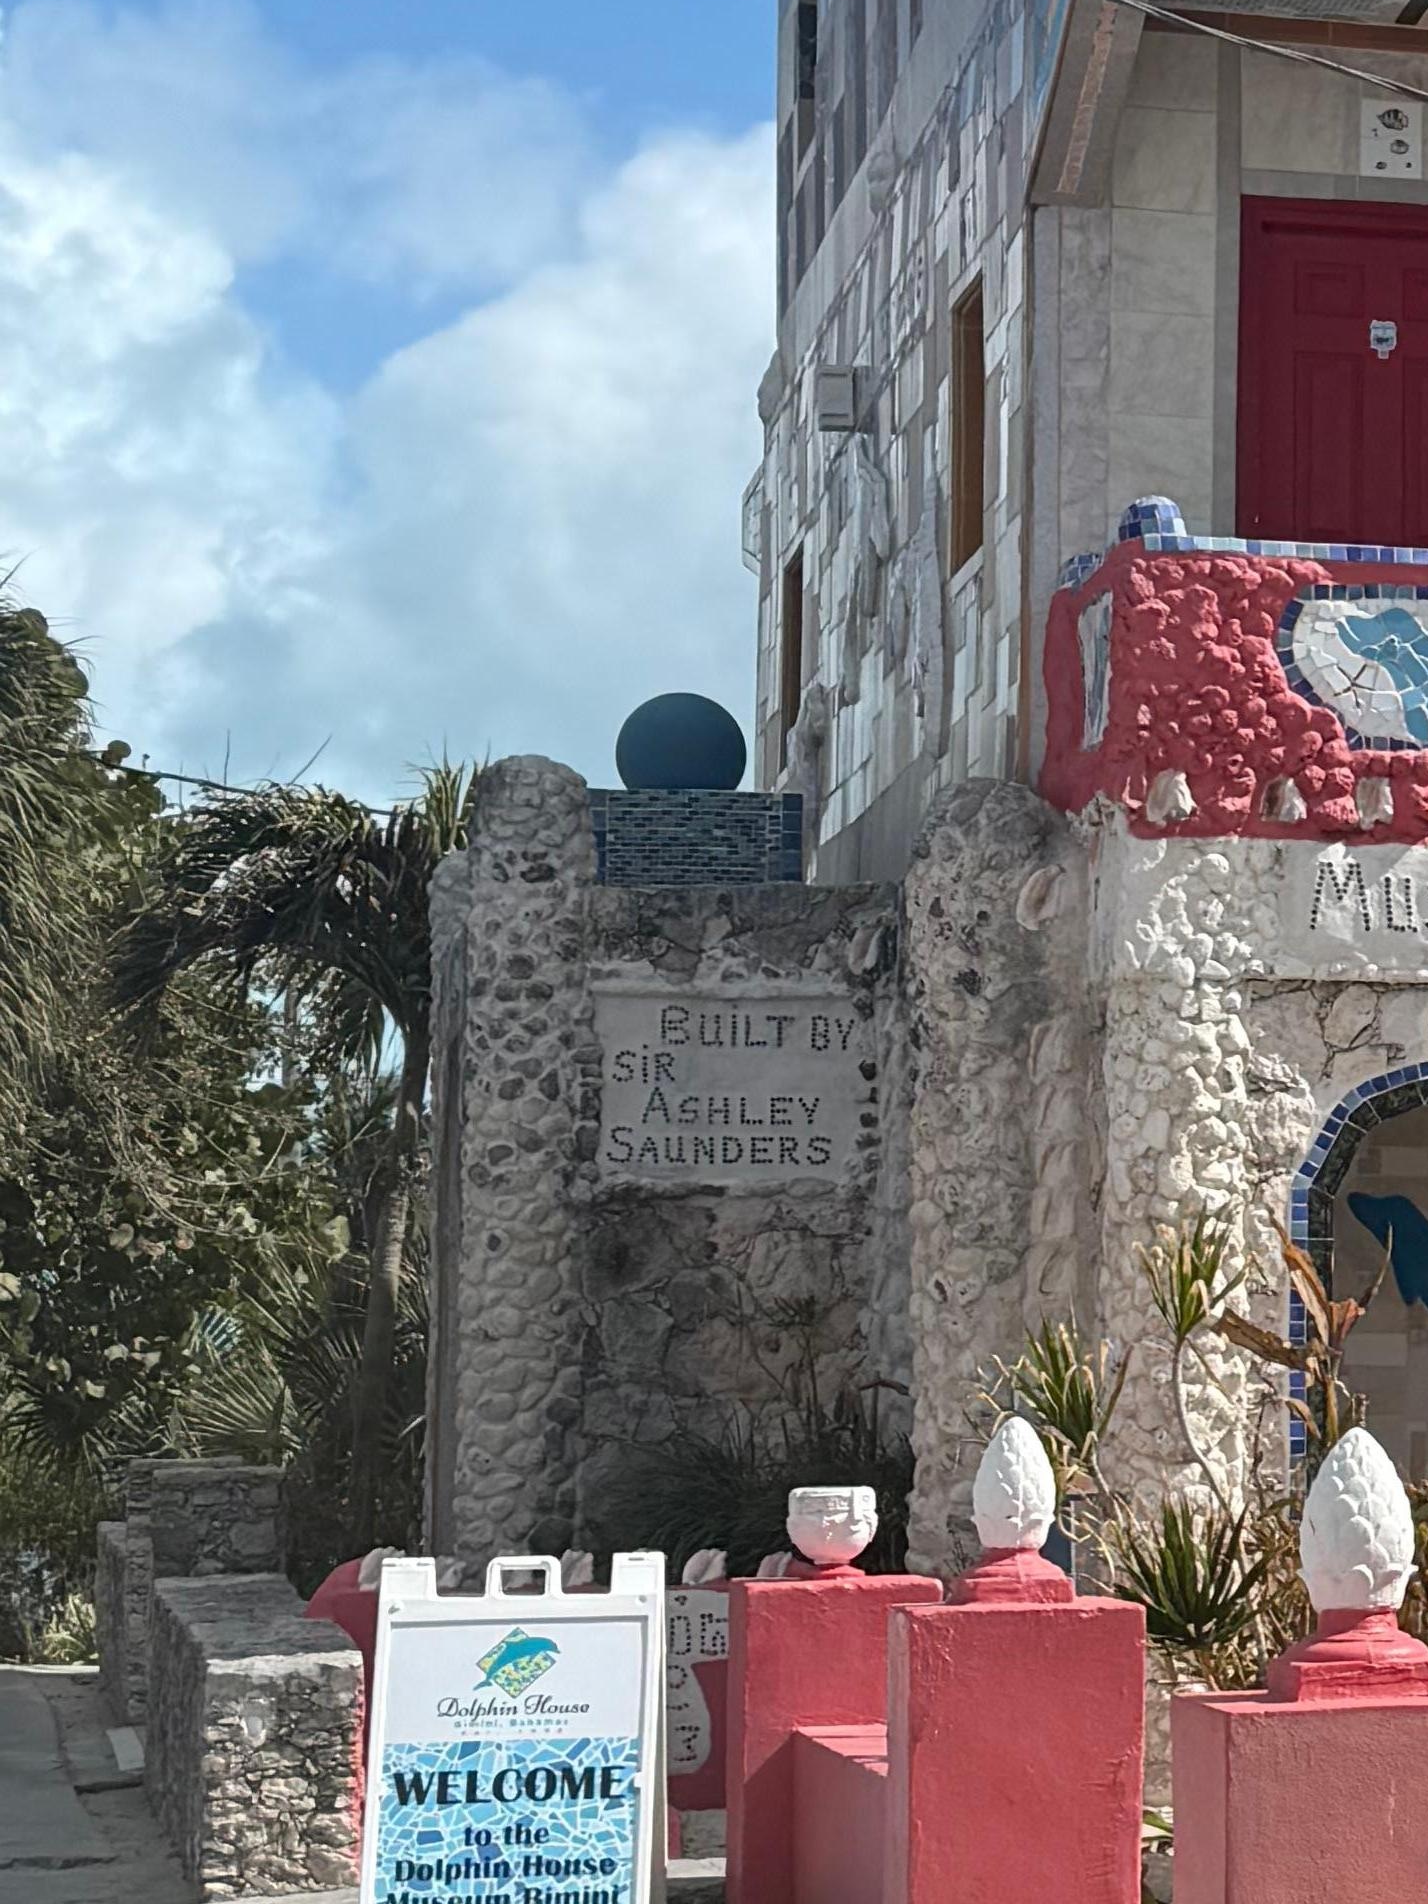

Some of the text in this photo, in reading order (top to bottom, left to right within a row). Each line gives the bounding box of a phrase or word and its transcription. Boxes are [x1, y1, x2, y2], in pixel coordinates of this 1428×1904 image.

[811, 1015, 855, 1051] BY
[641, 1086, 820, 1125] ASHLEY
[606, 1126, 832, 1166] SAUNDERS
[437, 1694, 590, 1722] Dolphin House
[393, 1765, 627, 1806] WELCOME
[464, 1823, 550, 1847] to the
[395, 1855, 618, 1886] Dolphin House
